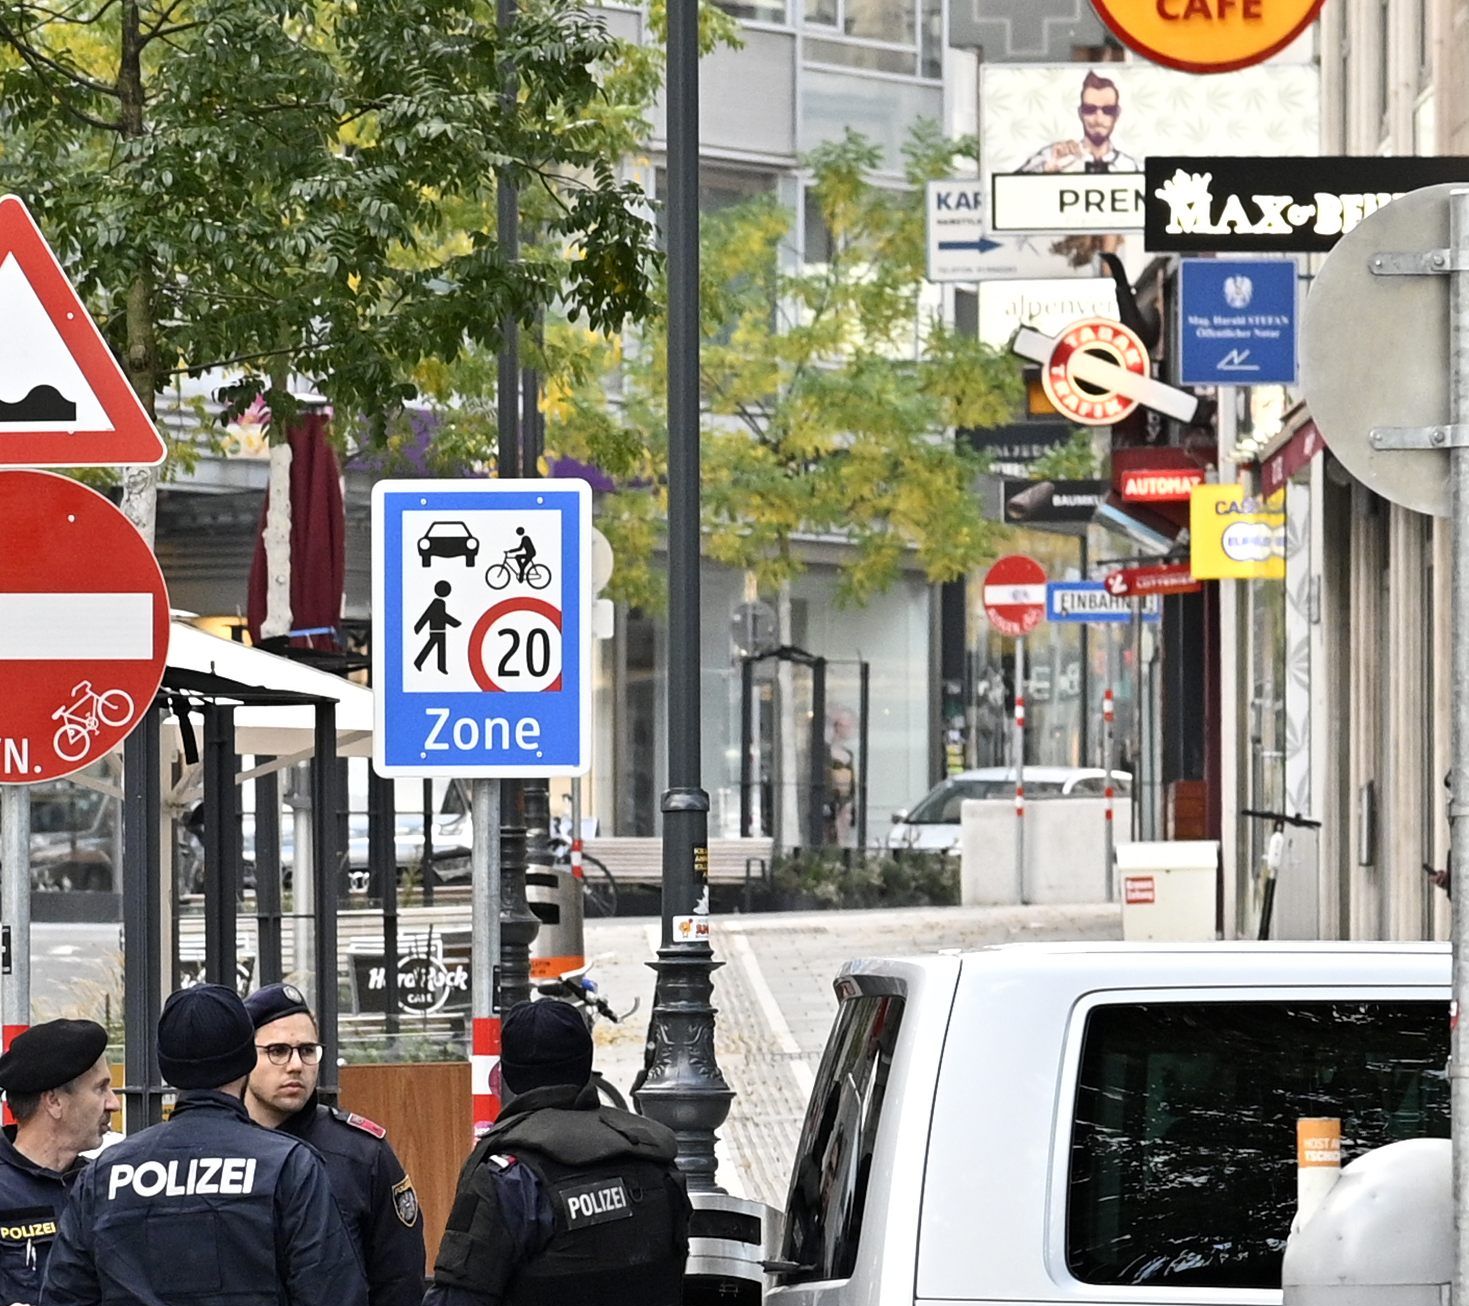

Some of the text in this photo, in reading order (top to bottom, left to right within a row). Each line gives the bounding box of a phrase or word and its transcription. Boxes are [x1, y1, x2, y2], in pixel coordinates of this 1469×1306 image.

[1155, 175, 1294, 234] MAX
[497, 628, 551, 677] 20
[424, 708, 541, 750] Zone
[108, 1157, 257, 1201] POLIZEI
[566, 1186, 627, 1220] POLIZEI
[0, 1221, 57, 1240] POLIZEI
